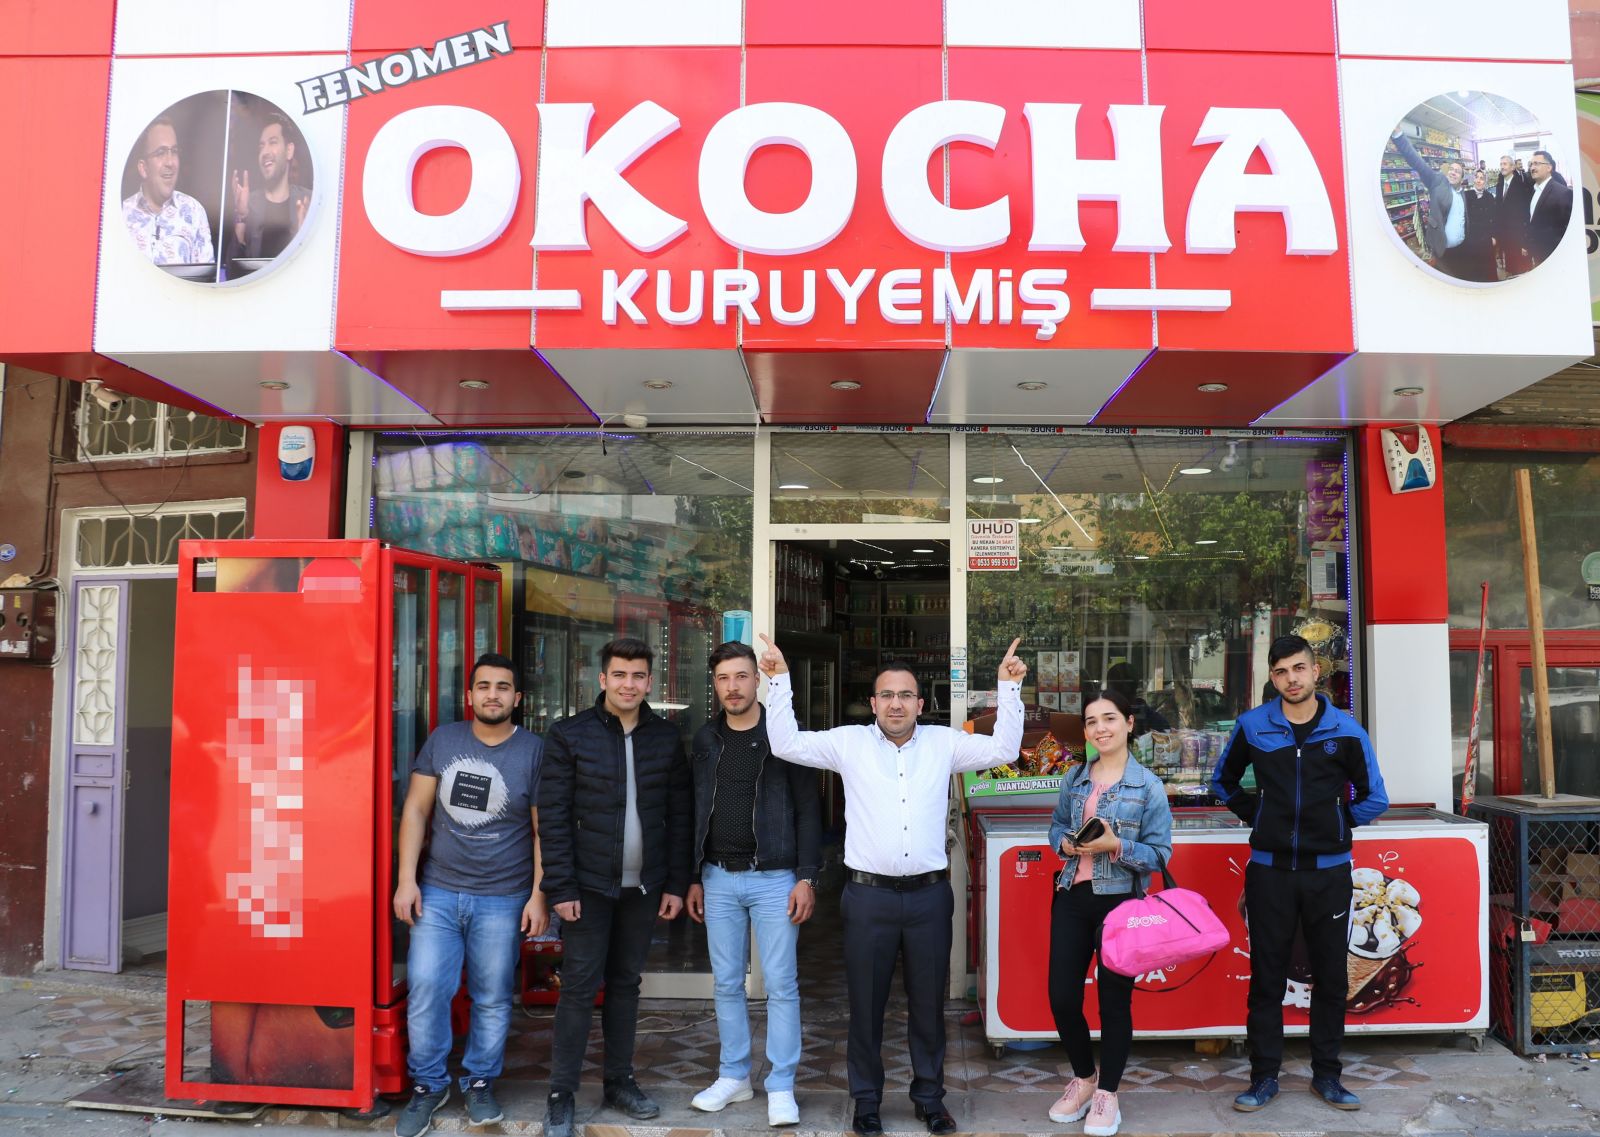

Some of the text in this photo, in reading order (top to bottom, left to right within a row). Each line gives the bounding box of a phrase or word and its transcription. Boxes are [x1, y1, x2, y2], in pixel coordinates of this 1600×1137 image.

[297, 21, 512, 114] FENOMEN
[361, 99, 1338, 257] OKOCHA
[972, 523, 1014, 534] UHUD
[996, 781, 1031, 793] AVANTAJ
